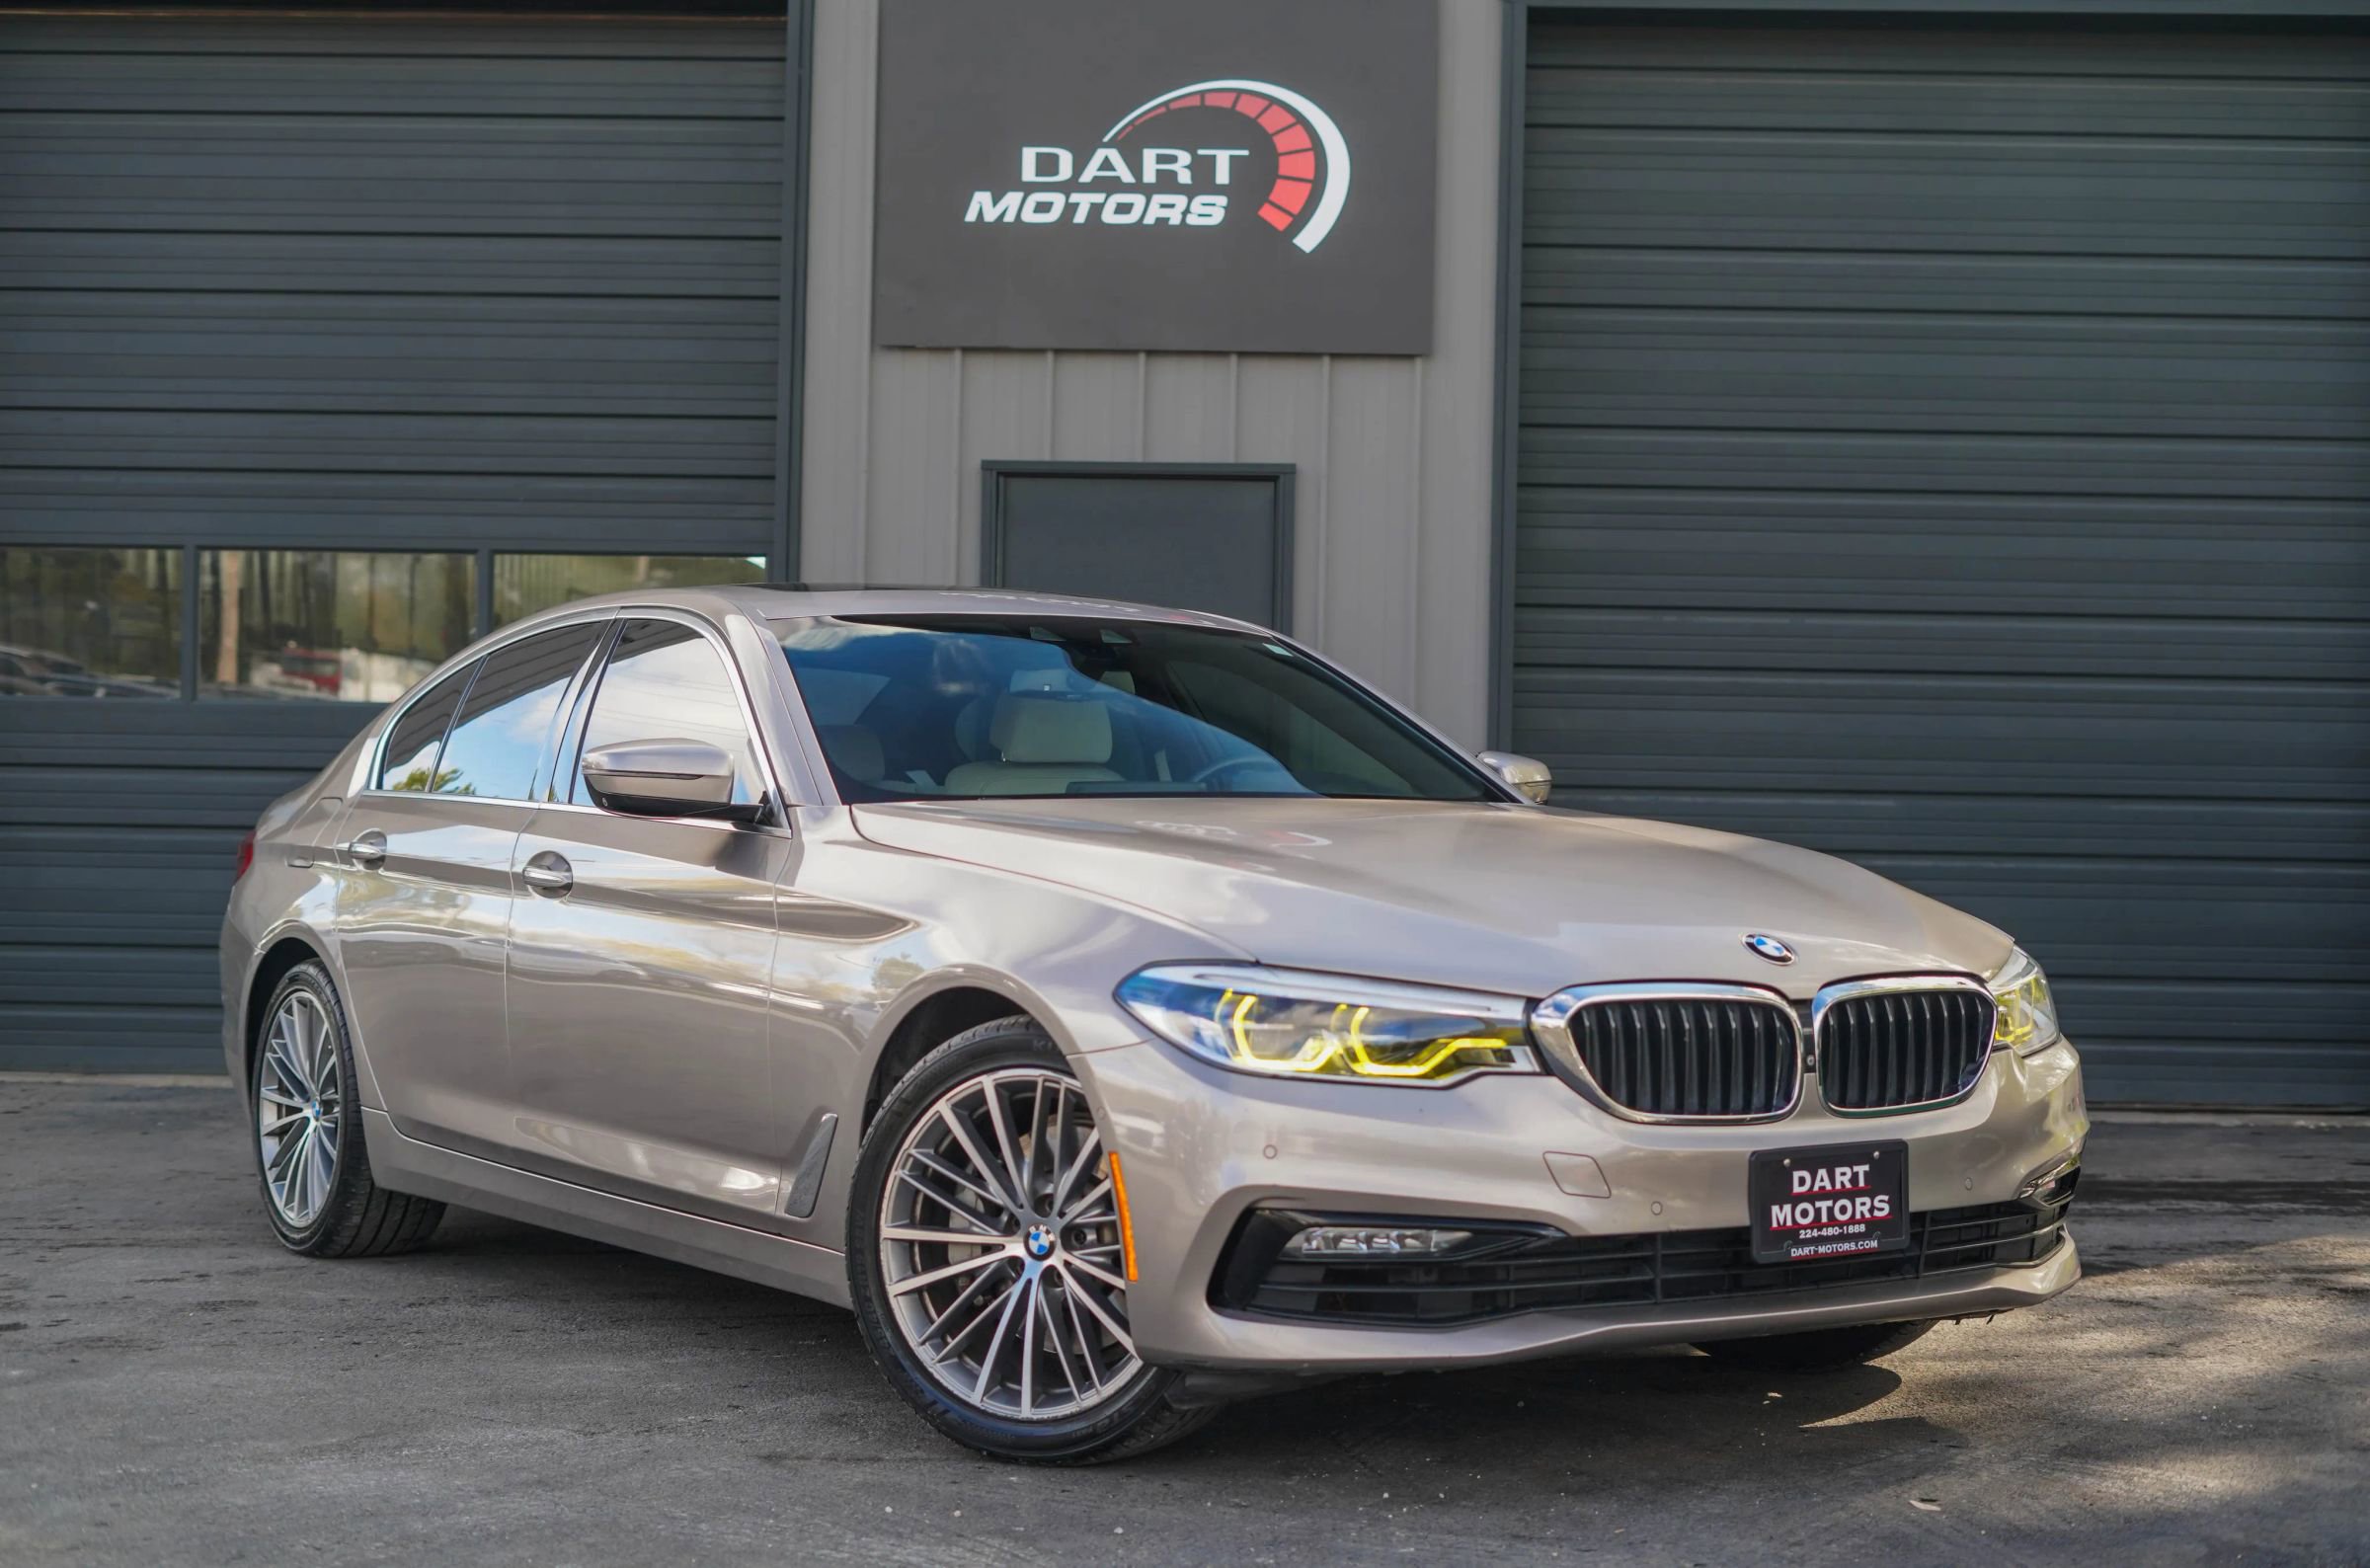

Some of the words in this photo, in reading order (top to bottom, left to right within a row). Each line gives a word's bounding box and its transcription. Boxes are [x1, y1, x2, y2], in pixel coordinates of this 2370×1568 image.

[1021, 146, 1250, 185] DART
[964, 191, 1228, 226] MOTORS
[1792, 1164, 1870, 1193] DART
[1771, 1195, 1890, 1227] MOTORS
[1799, 1223, 1866, 1239] 224-480-1888
[1790, 1239, 1878, 1257] DART-MOTORS.COM
